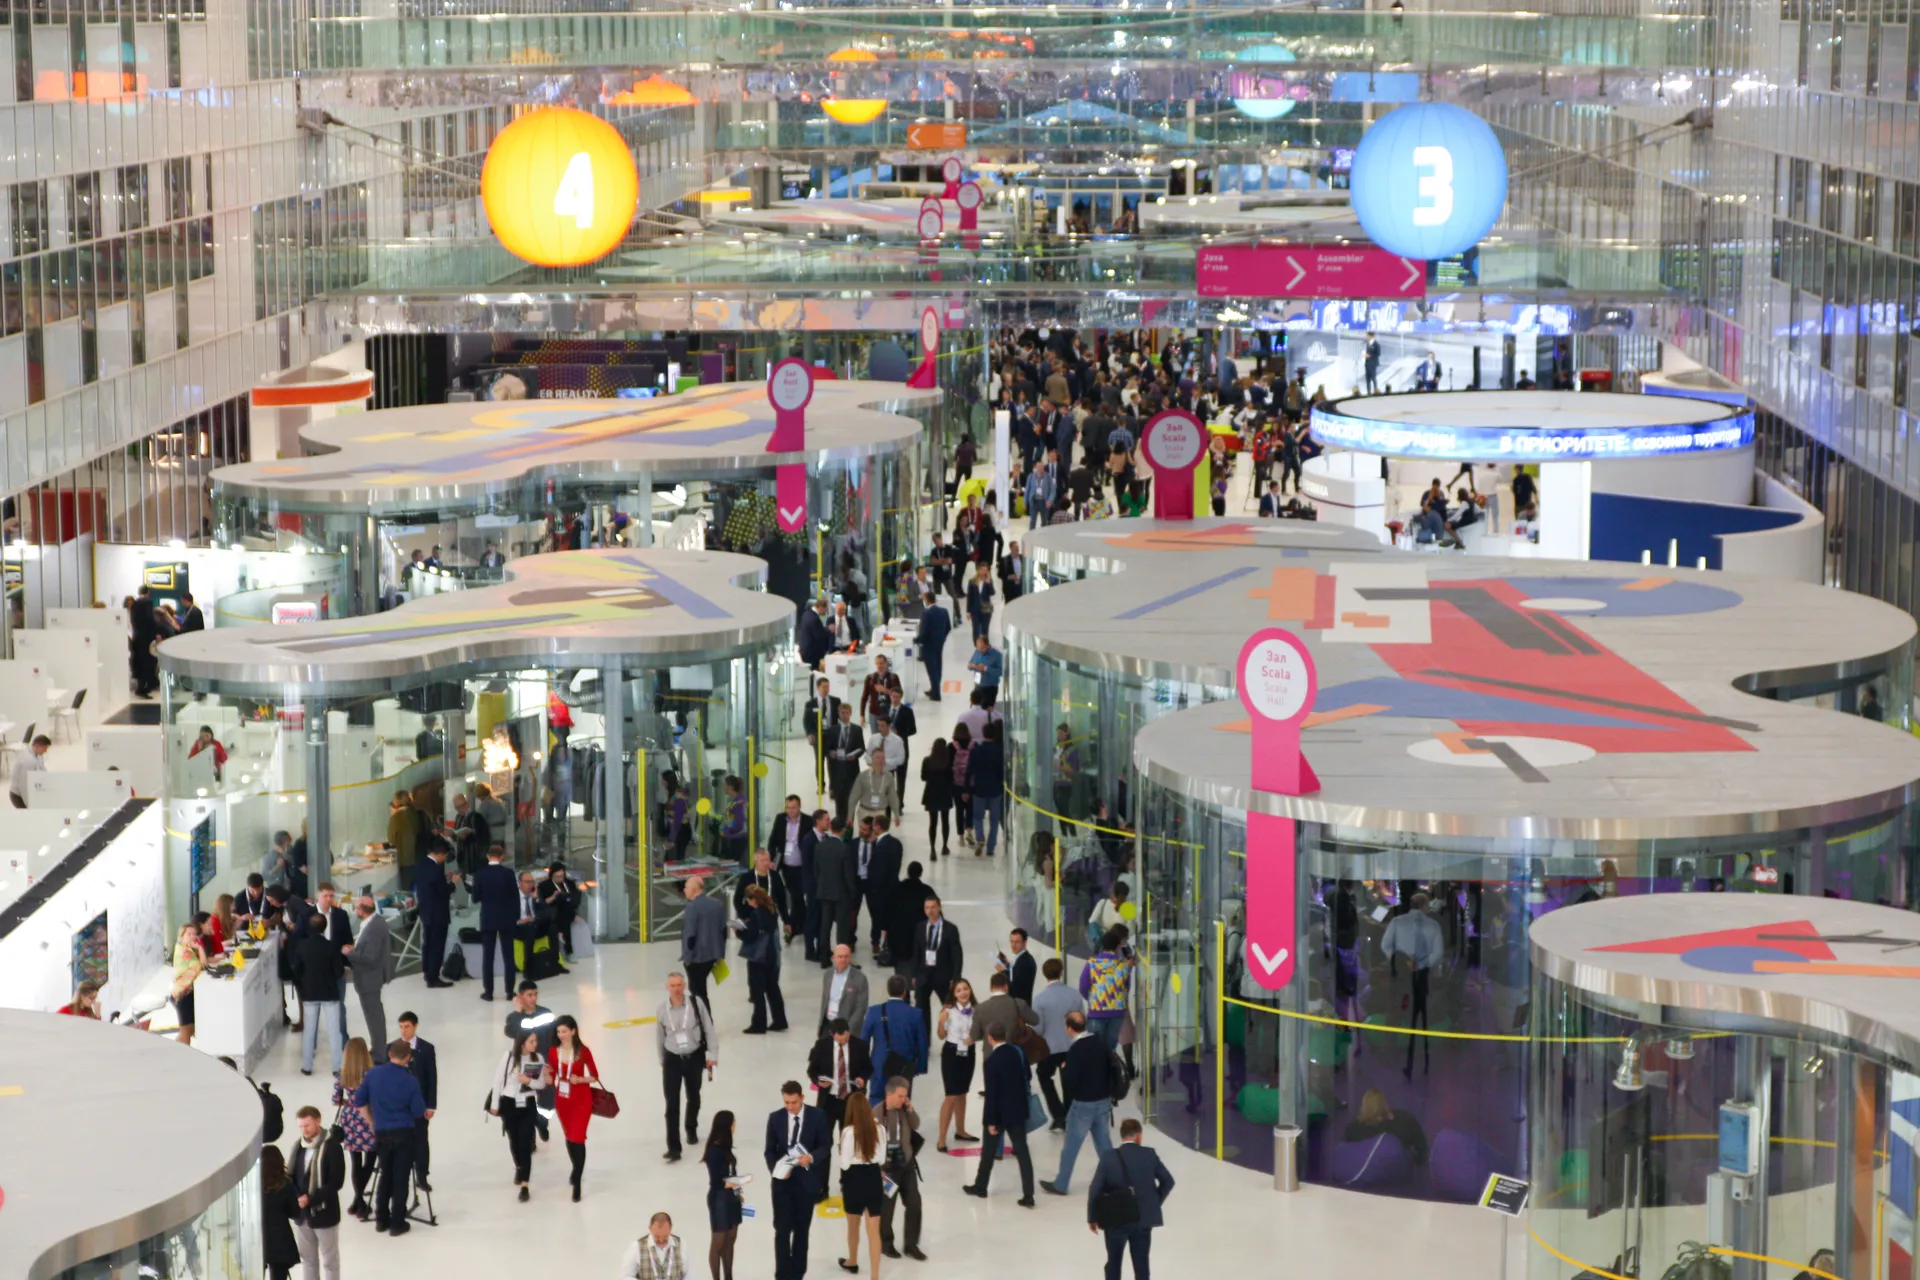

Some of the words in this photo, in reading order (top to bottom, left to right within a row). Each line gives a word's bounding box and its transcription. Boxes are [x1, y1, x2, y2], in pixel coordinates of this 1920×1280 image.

[554, 152, 594, 228] 4
[1413, 146, 1454, 226] 3
[1203, 253, 1224, 262] Java
[1317, 253, 1364, 263] Assembler
[555, 388, 599, 399] REALITY
[1166, 423, 1183, 432] Зал
[1162, 433, 1187, 442] Scala
[1500, 436, 1512, 452] В
[1517, 435, 1630, 454] ПРИОРИТЕТЕ:
[1266, 649, 1287, 663] Зал
[1262, 665, 1291, 680] Scala
[1264, 681, 1288, 694] Scala
[1267, 695, 1285, 706] Hall
